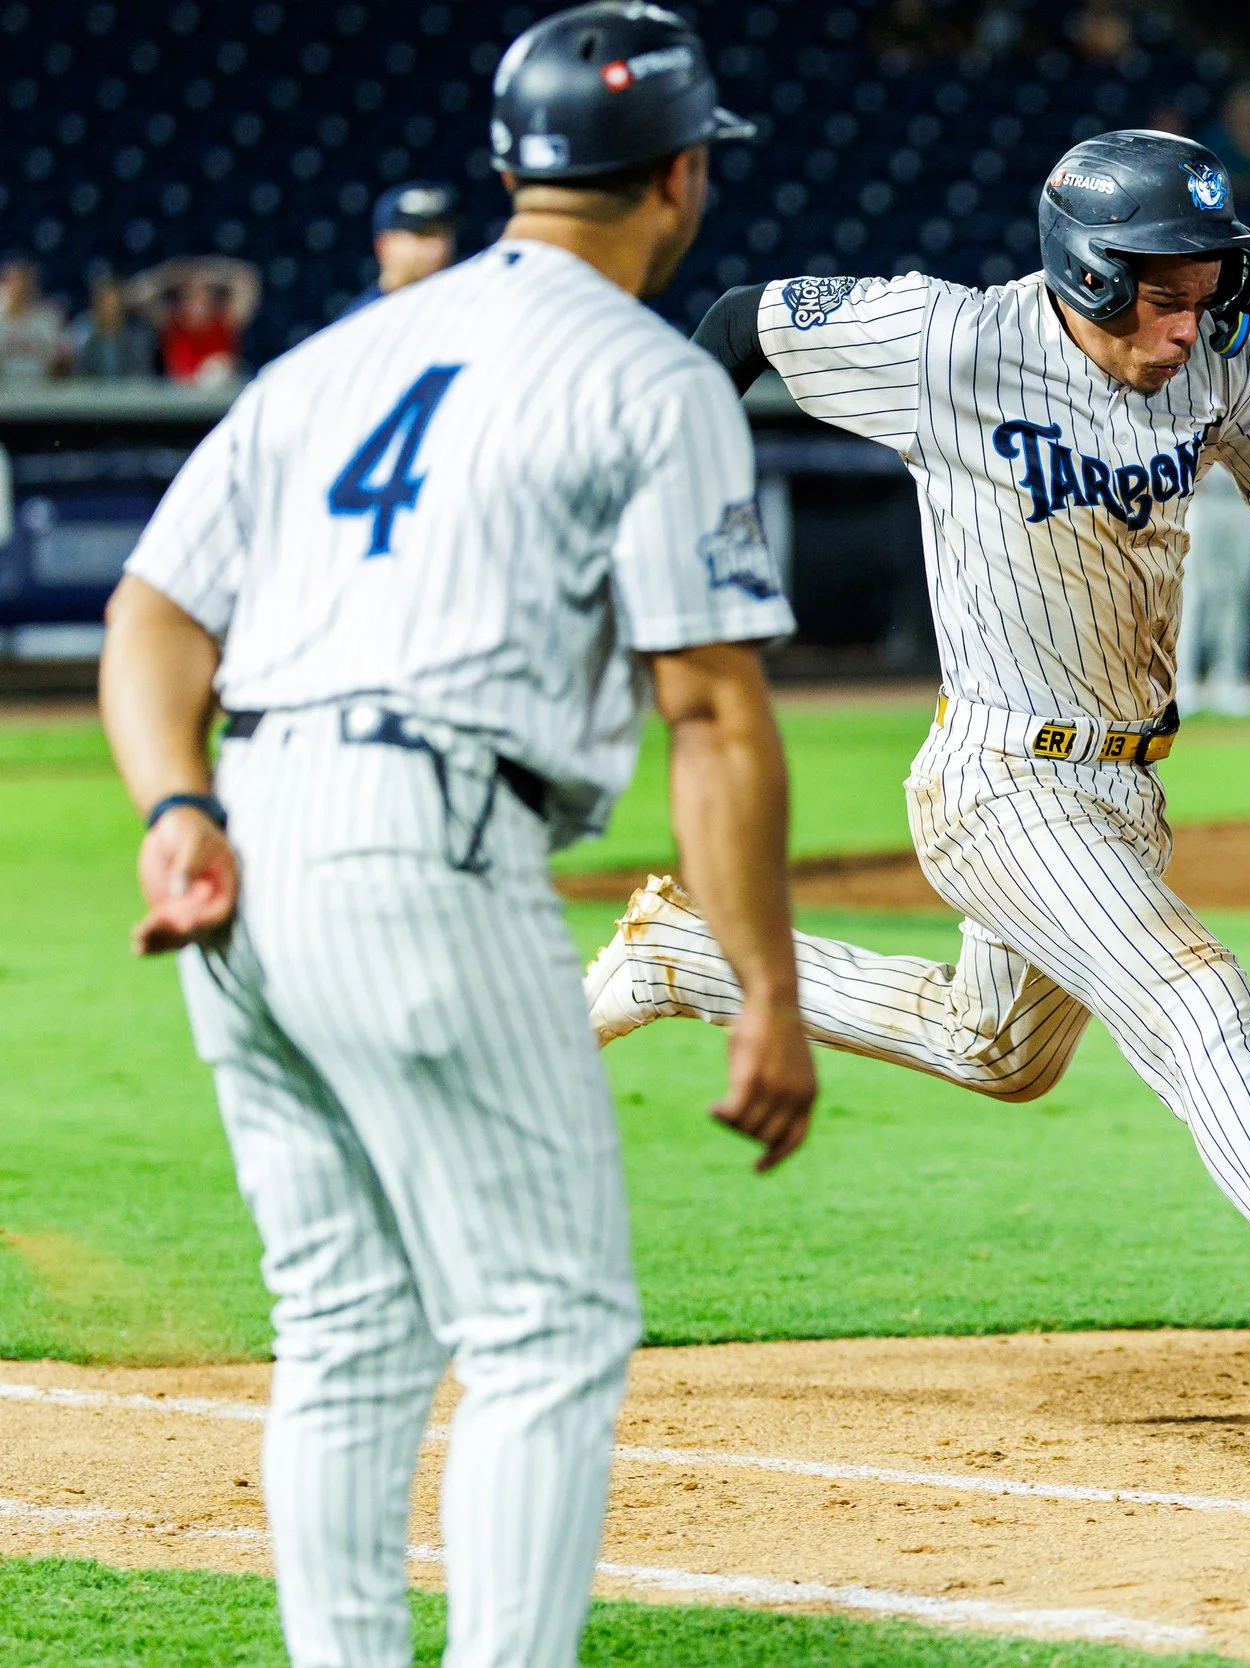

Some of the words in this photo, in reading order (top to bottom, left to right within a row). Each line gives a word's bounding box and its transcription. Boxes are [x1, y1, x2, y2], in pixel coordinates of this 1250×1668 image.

[1062, 173, 1116, 195] STRAUSS
[328, 362, 464, 556] 4
[992, 418, 1214, 531] TARPON
[1101, 735, 1126, 757] 13
